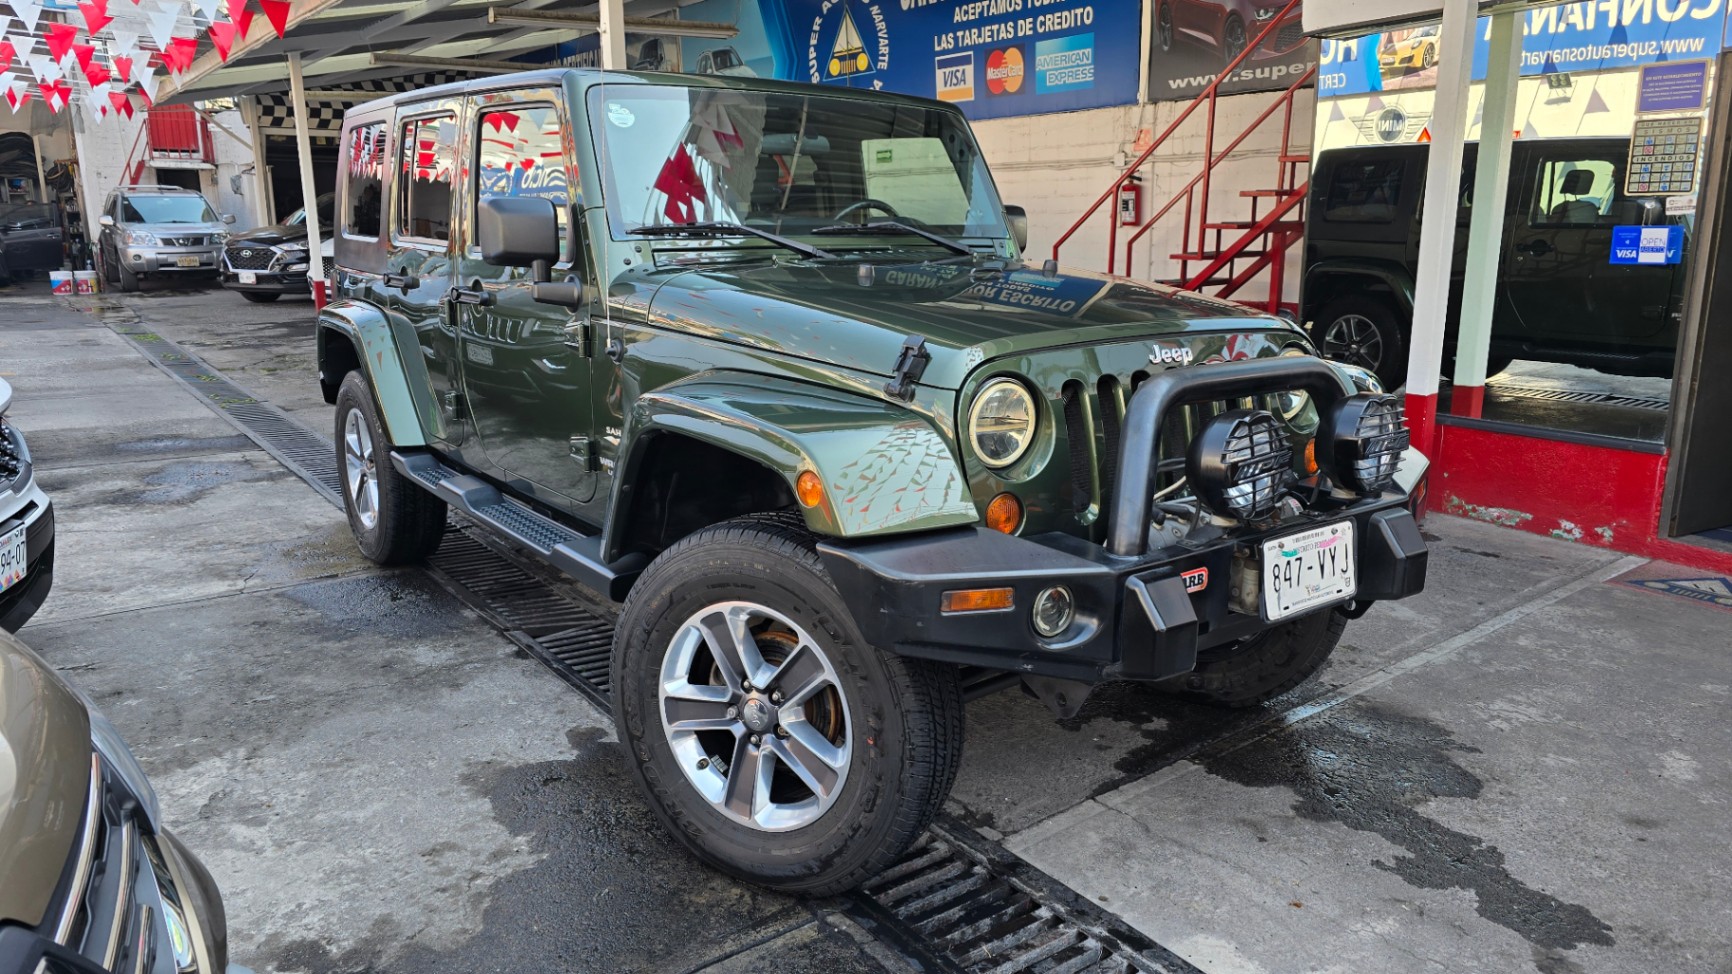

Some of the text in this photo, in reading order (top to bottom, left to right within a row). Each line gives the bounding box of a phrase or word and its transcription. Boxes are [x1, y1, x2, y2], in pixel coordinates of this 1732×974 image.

[953, 0, 1023, 23] ACEPTAMOS
[869, 5, 889, 70] NARVARTE
[934, 6, 1094, 51] LAS TARJETAS DE CREDITO
[809, 16, 823, 84] SUPER
[1036, 49, 1091, 70] AMERICAN
[942, 69, 966, 87] VISA
[986, 63, 1024, 80] MasterCard
[1047, 65, 1094, 86] EXPRESS
[1643, 127, 1691, 136] SISMOS
[1616, 249, 1637, 258] VISA
[1149, 344, 1193, 366] Jeep
[1272, 543, 1349, 593] 847-VYJ
